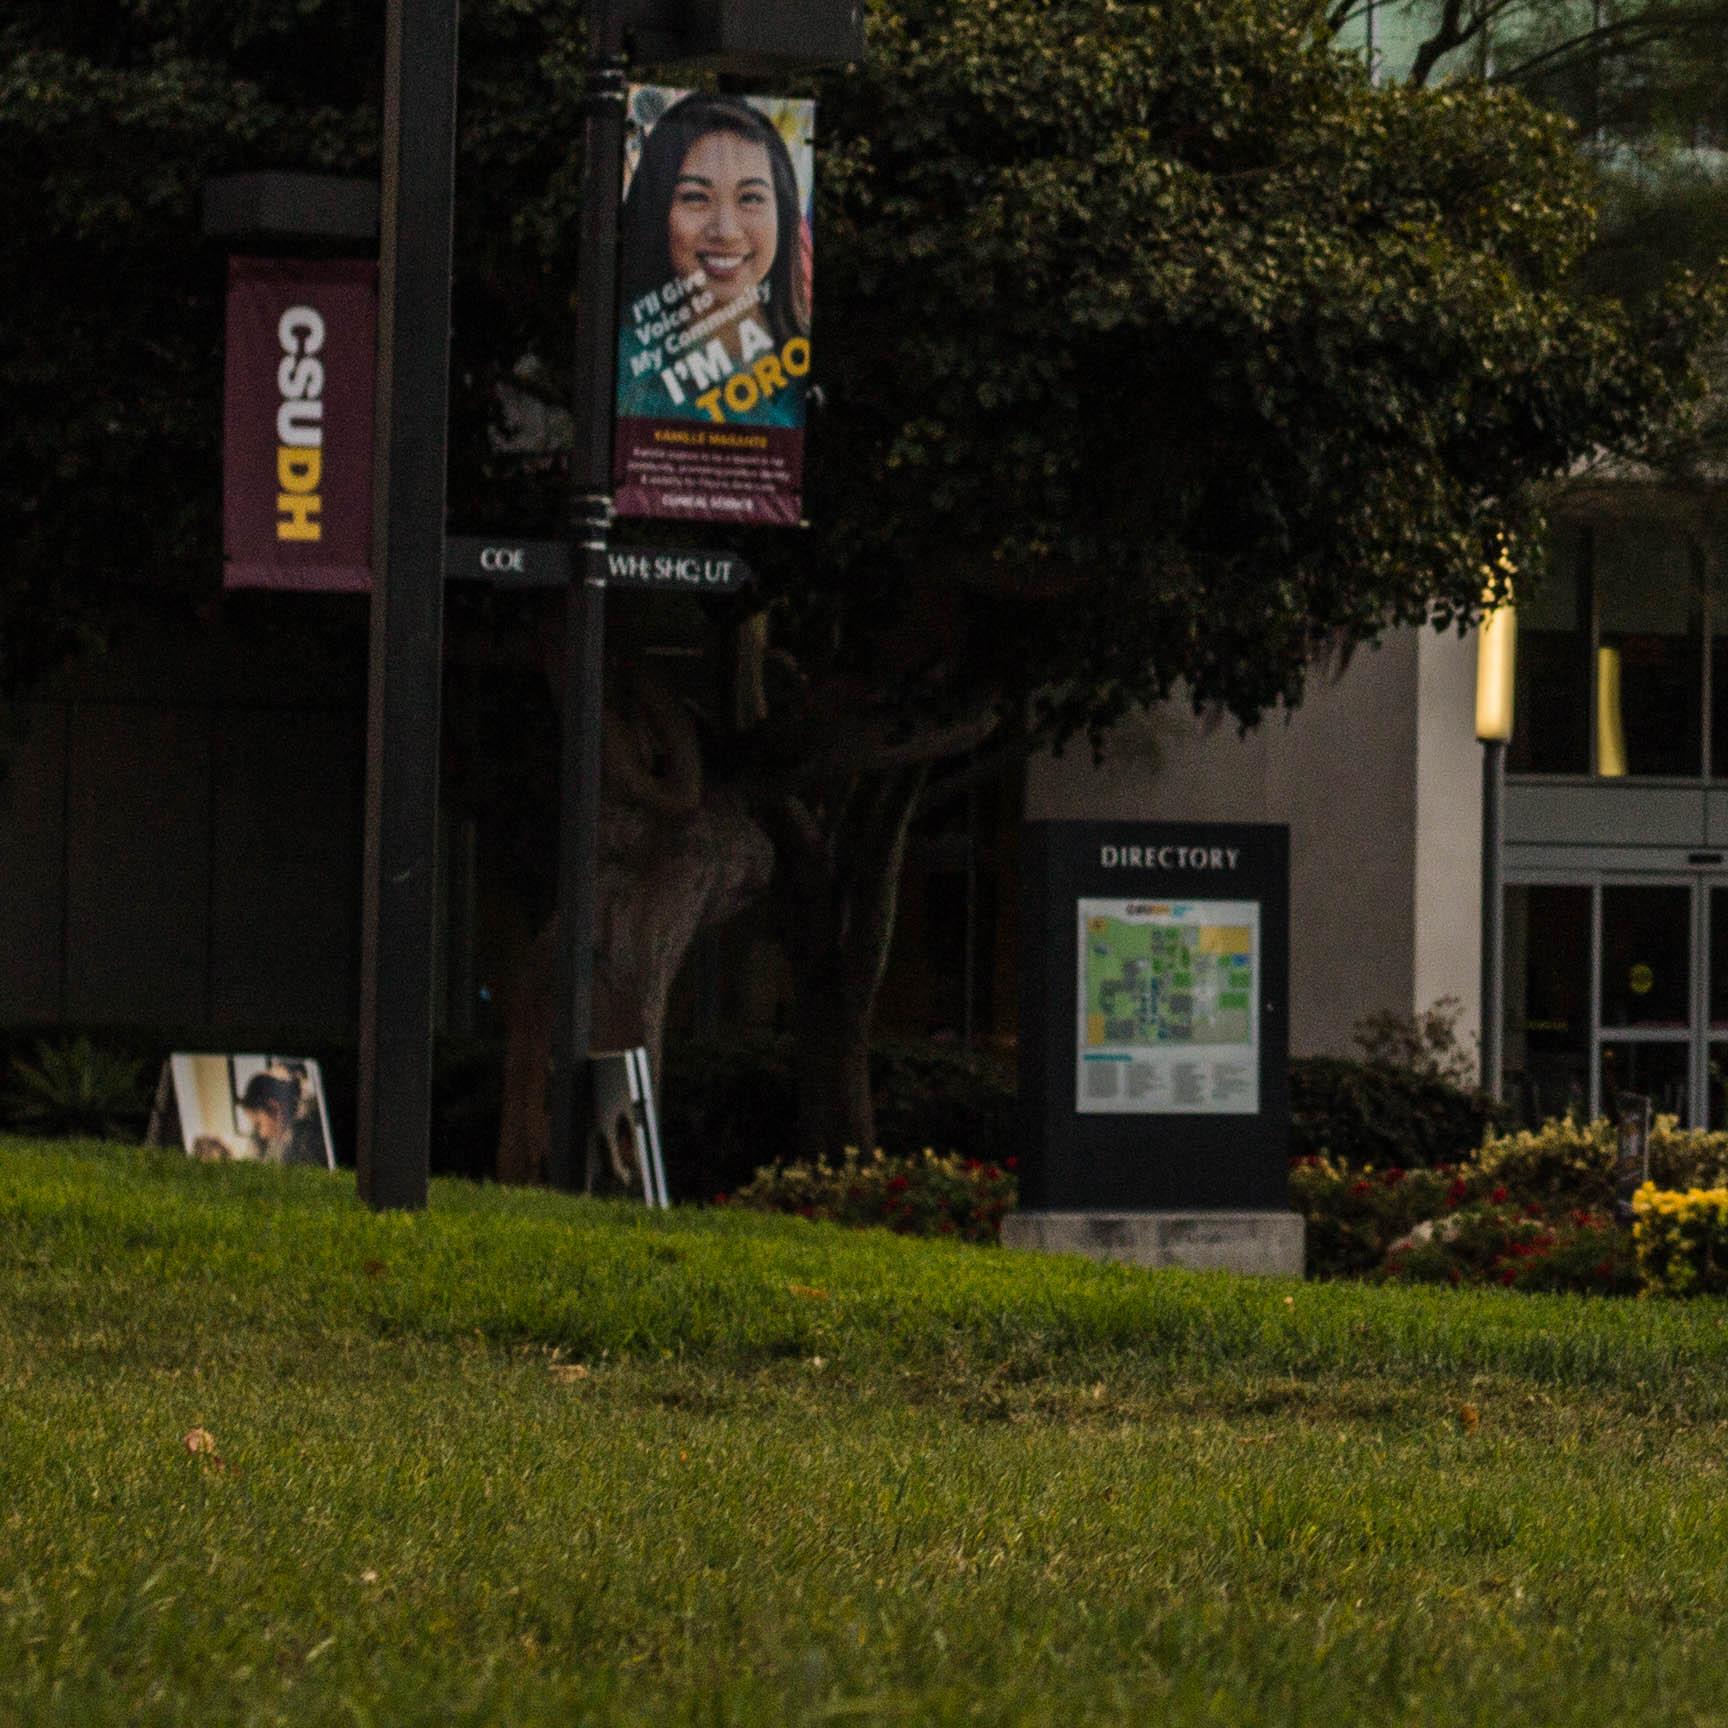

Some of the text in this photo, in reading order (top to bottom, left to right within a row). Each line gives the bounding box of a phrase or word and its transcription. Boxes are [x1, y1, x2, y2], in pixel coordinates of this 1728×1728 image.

[629, 280, 771, 377] My Community
[632, 269, 708, 323] I'll Give
[635, 290, 715, 346] Voice to
[660, 318, 774, 405] I'M A
[695, 337, 811, 424] TORO
[275, 304, 326, 544] CSUDH
[704, 559, 733, 584] UT
[1100, 845, 1241, 871] DIRECTORY
